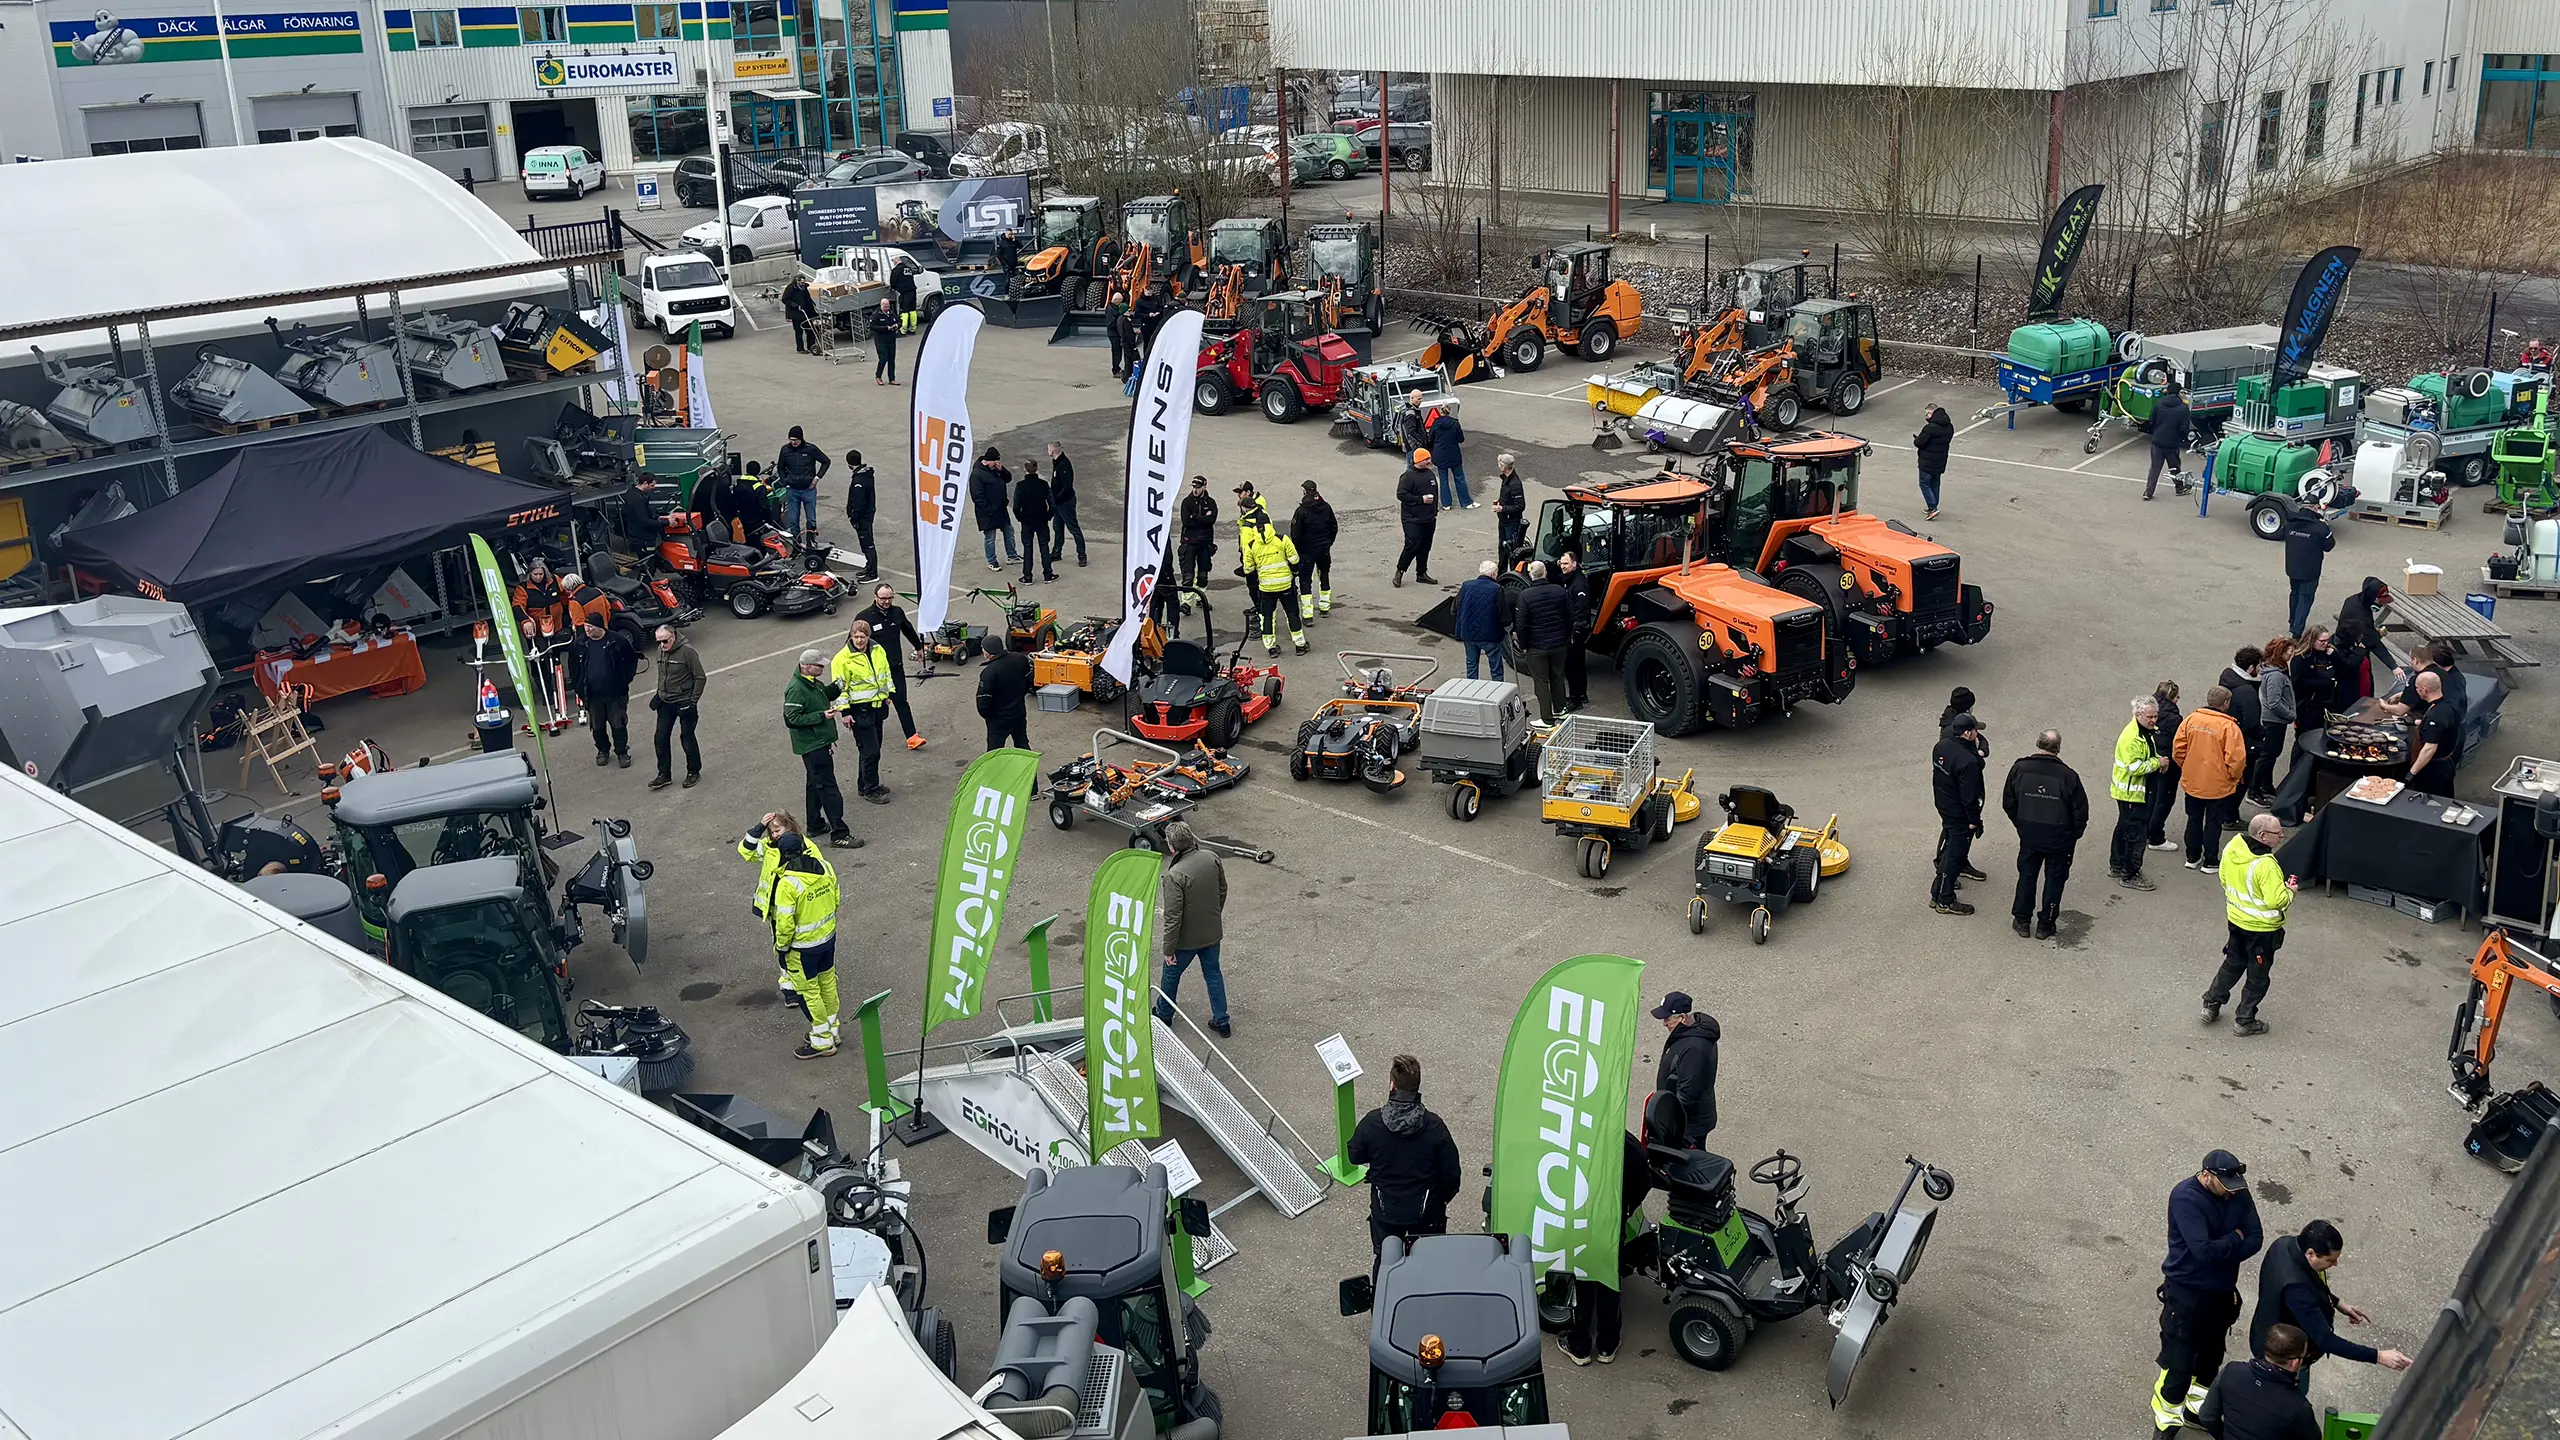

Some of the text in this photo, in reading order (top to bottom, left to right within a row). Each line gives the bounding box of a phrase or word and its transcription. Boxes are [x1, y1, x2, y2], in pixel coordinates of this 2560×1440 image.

[157, 16, 354, 33] DÄCK ÄLGAR FÖRVARING
[567, 61, 673, 79] EUROMASTER
[752, 63, 777, 71] SYSTEM
[643, 184, 652, 195] P
[968, 203, 1018, 228] LST
[2041, 198, 2085, 293] K-HEAT
[2284, 254, 2344, 361] K-VAGNEN
[918, 411, 946, 525] HS
[1146, 361, 1173, 555] ARIENS
[941, 422, 966, 531] MOTOR
[506, 504, 560, 527] STIHL
[137, 578, 167, 602] STIHL
[1841, 575, 1853, 588] 50
[1737, 618, 1758, 630] Lundberg
[1700, 634, 1712, 647] 50
[944, 785, 1015, 1016] EGHOLM
[1102, 891, 1147, 1132] EGHOLM
[962, 1096, 1040, 1164] EGHOLM
